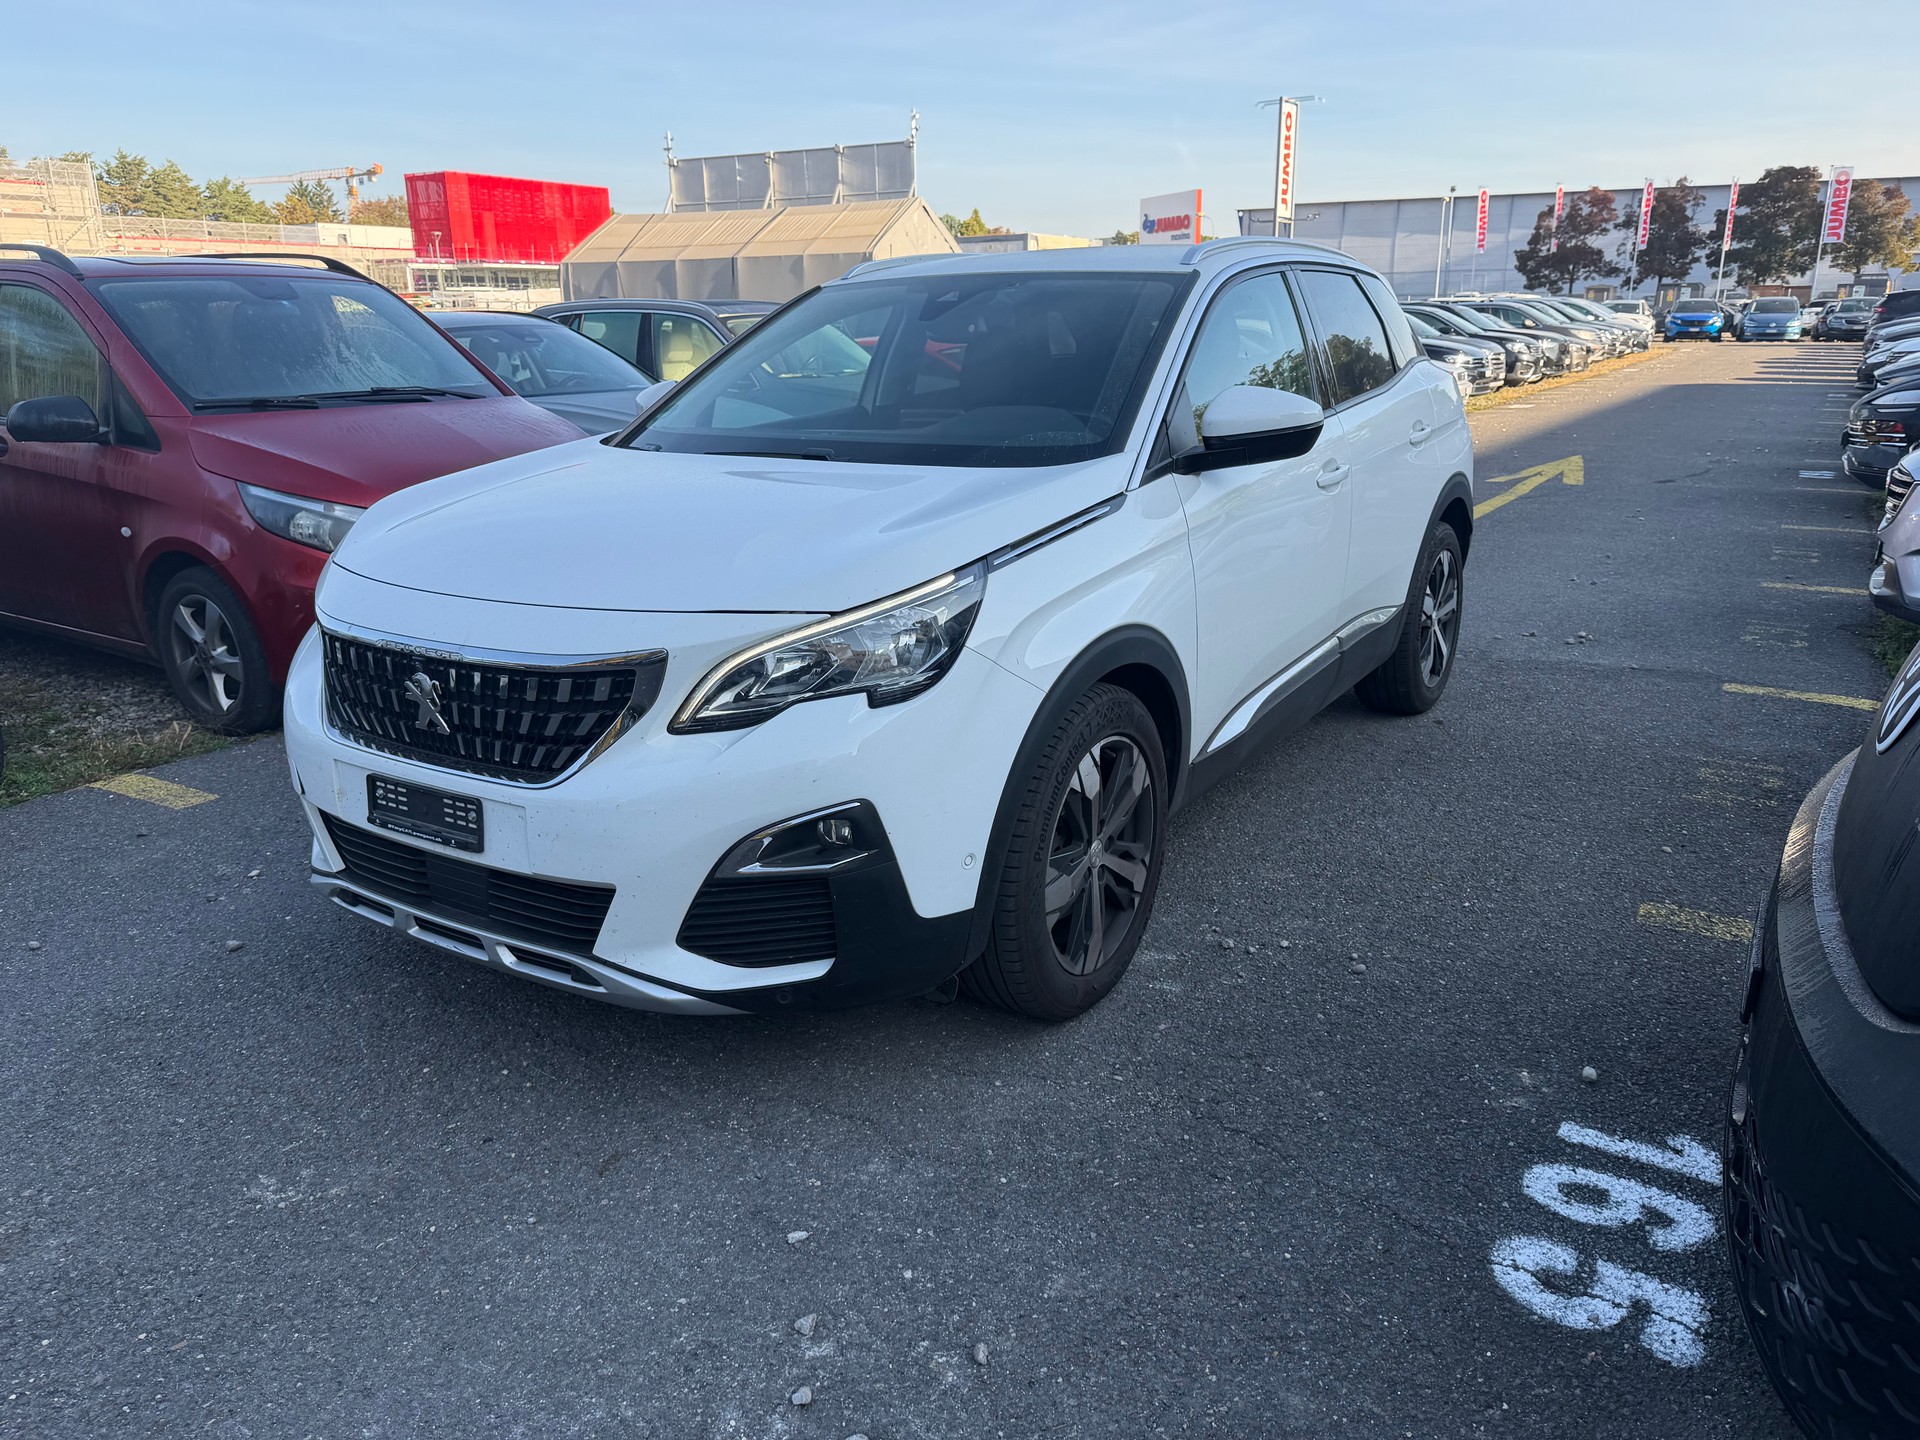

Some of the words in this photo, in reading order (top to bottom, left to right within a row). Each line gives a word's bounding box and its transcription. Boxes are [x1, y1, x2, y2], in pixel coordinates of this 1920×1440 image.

[1281, 111, 1293, 211] JUMBO
[1154, 214, 1191, 233] JUMBO
[1477, 190, 1489, 250] JUMBO
[1827, 170, 1851, 241] JUMBO
[384, 640, 456, 660] PEUGEOT
[1033, 733, 1087, 863] PremiumContact
[1085, 723, 1095, 738] 7
[1490, 1120, 1723, 1368] 165
